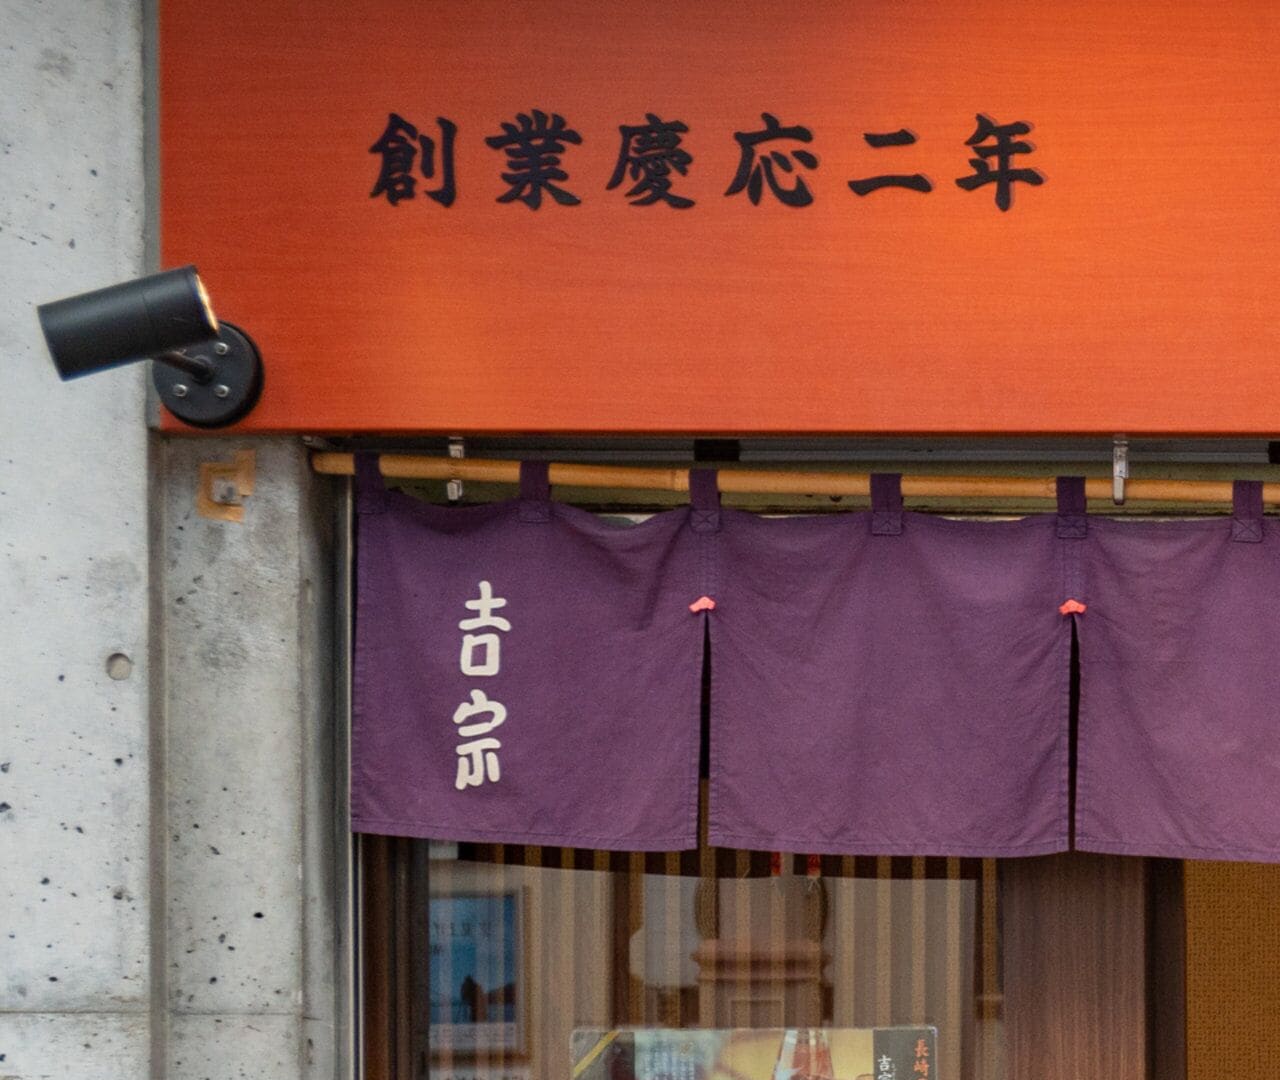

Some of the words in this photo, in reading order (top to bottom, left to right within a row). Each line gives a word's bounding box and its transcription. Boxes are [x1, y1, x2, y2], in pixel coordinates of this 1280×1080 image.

[368, 108, 1046, 213] 創業慶応二年
[453, 580, 511, 790] 吉宗
